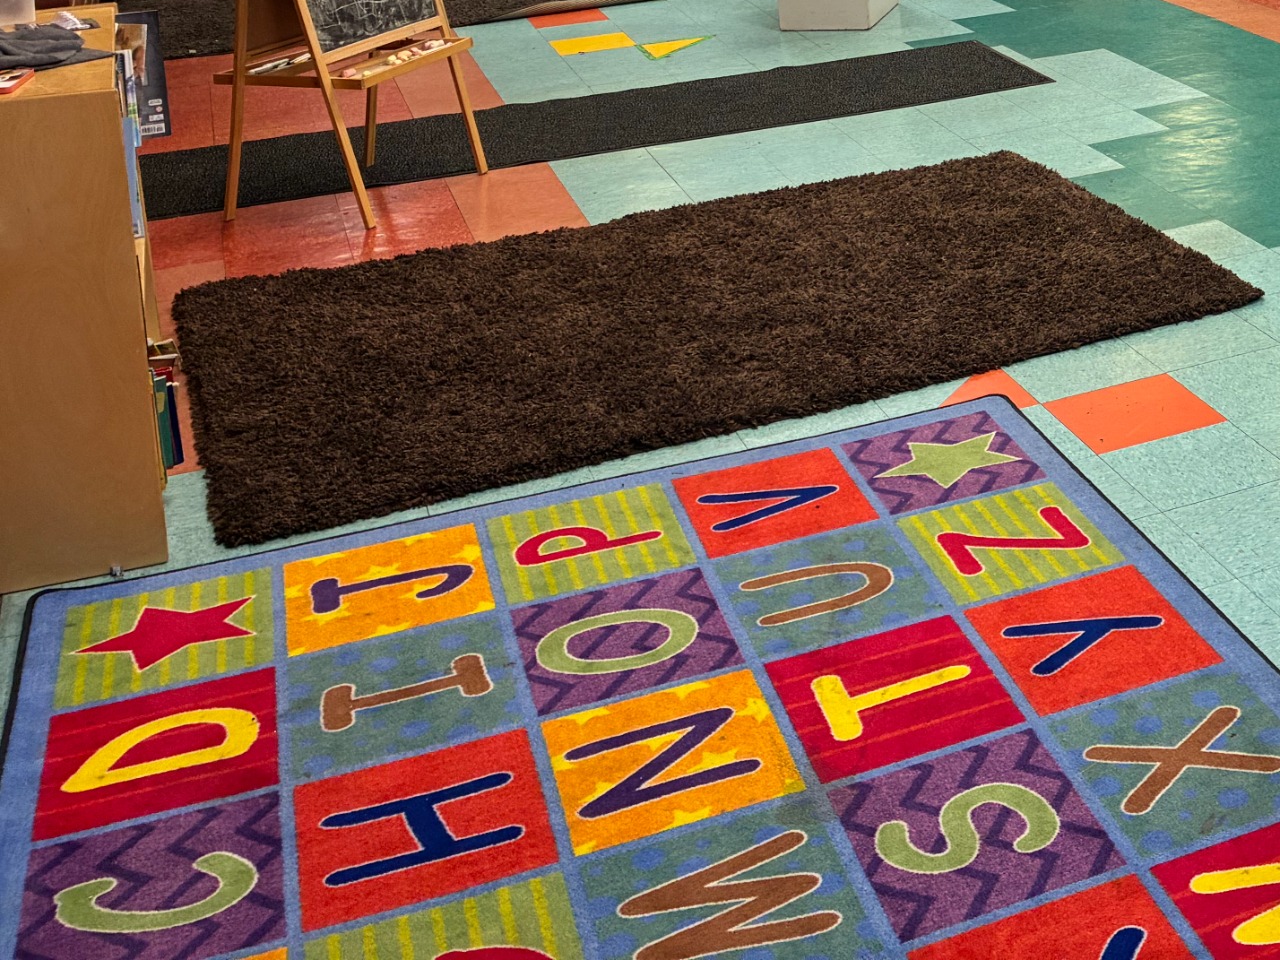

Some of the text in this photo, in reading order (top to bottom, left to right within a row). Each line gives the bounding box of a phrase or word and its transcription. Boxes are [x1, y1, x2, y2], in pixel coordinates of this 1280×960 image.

[696, 484, 840, 532] V
[937, 505, 1091, 576] Z
[513, 525, 665, 569] P
[309, 563, 475, 614] J
[738, 560, 895, 626] U
[534, 608, 702, 674] O
[1002, 614, 1164, 677] Y
[320, 653, 495, 733] I
[810, 664, 971, 743] T
[60, 707, 260, 793] D
[564, 706, 763, 820] N
[319, 771, 525, 887] H
[874, 781, 1061, 875] S
[54, 851, 260, 933] C
